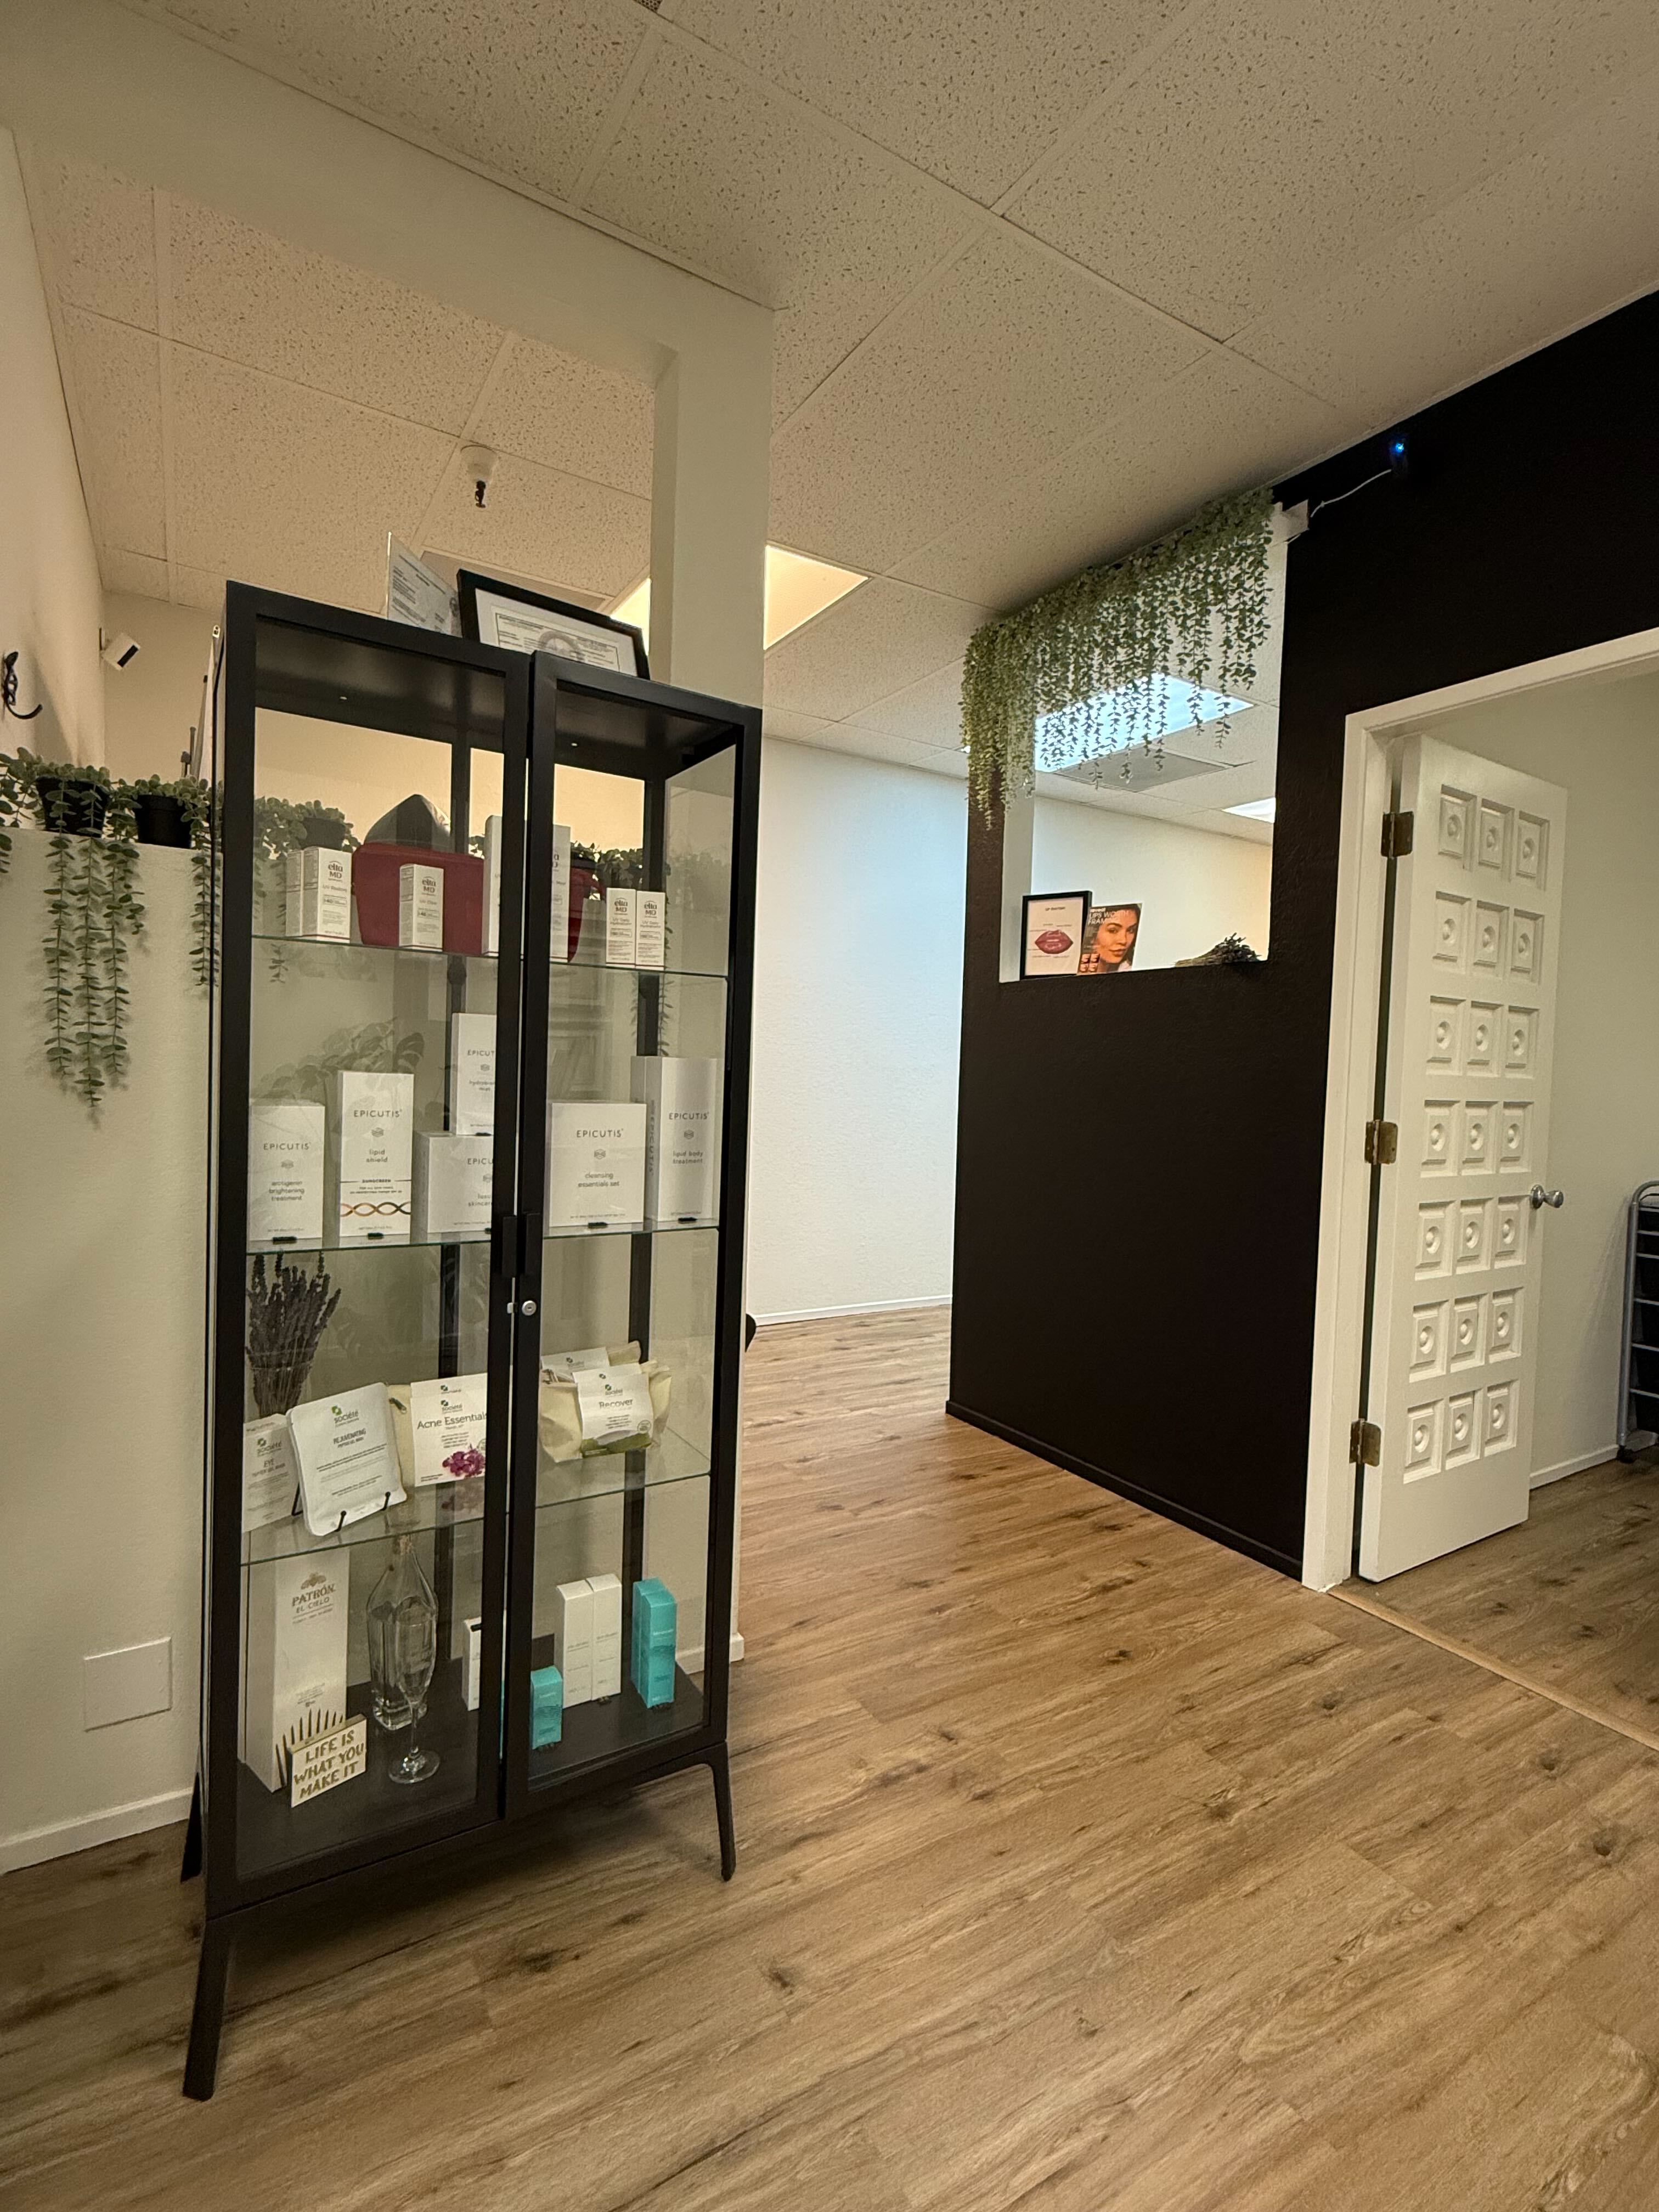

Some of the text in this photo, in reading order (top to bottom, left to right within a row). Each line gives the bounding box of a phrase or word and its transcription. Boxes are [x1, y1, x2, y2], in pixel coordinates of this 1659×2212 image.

[599, 1399, 633, 1408] Recover
[417, 1419, 442, 1430] Acne
[292, 1583, 336, 1607] PATRÓN
[308, 1596, 330, 1609] CIELO
[306, 1730, 354, 1764] LIFE IS
[294, 1742, 364, 1785] WHAT YOU
[300, 1761, 359, 1799] MAKE IT
